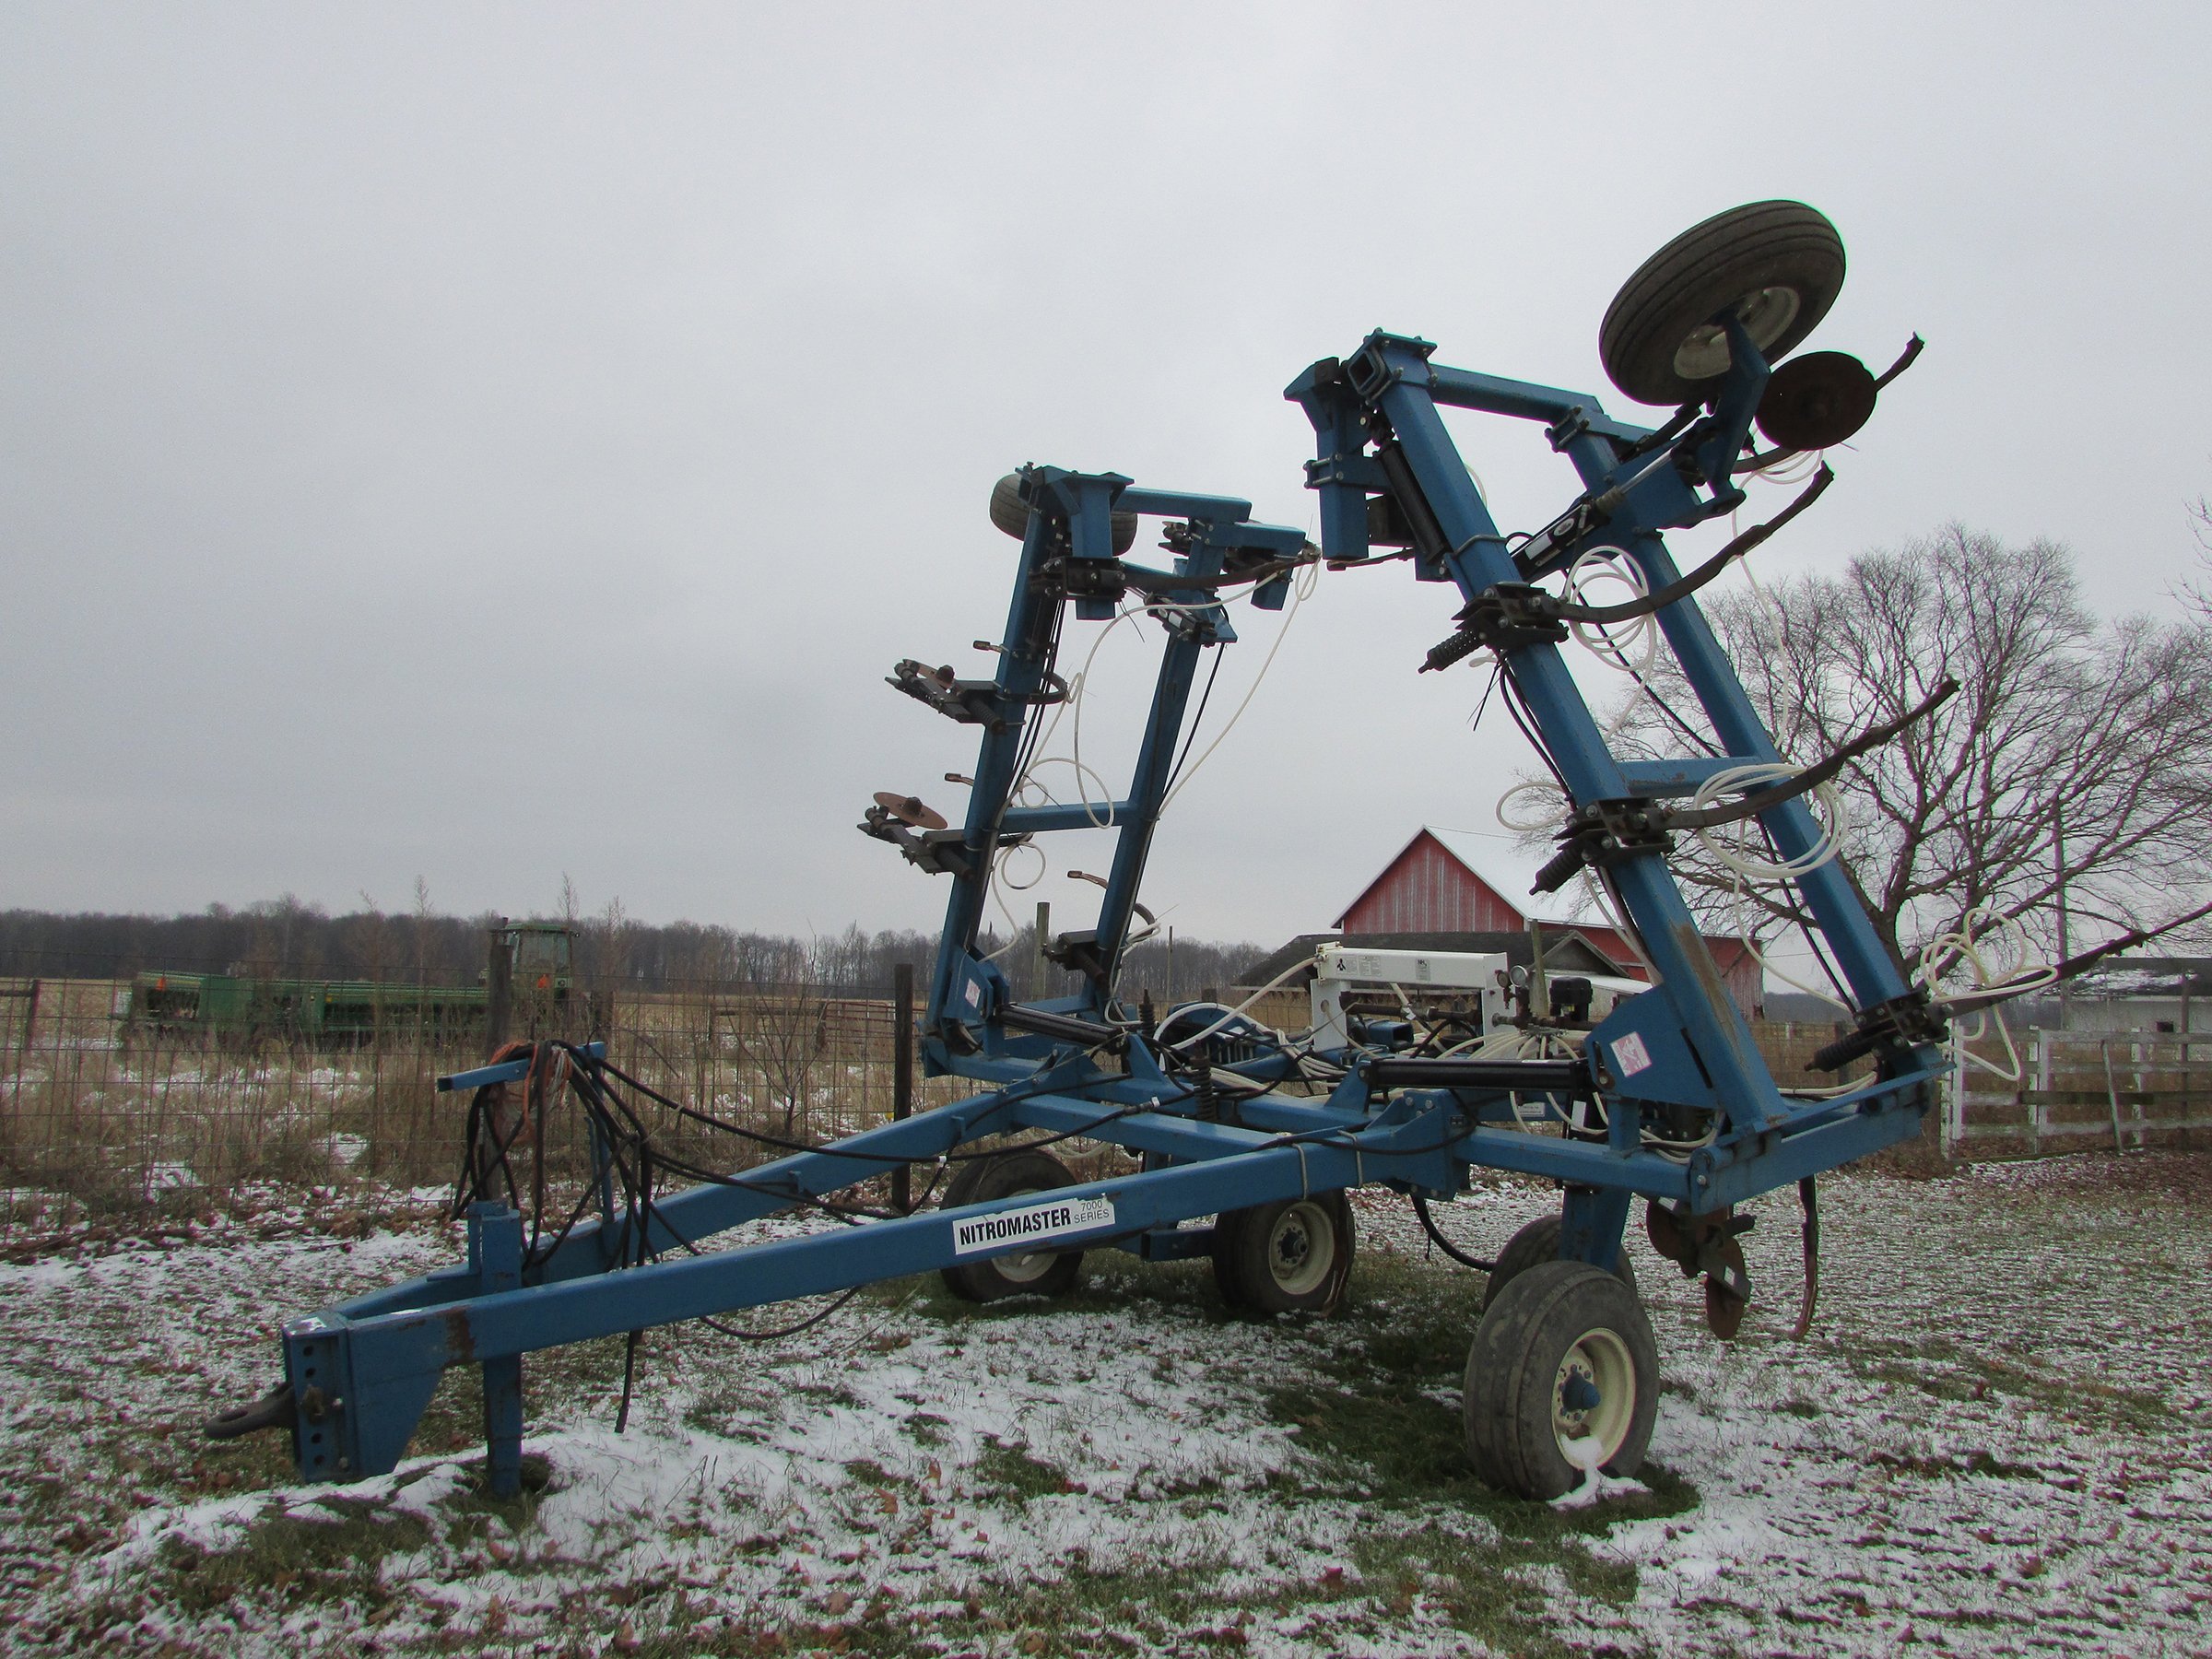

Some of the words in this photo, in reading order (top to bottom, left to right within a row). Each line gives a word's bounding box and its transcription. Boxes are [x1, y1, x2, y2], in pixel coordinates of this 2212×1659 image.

[1080, 1200, 1103, 1212] 7000
[1074, 1209, 1110, 1224] SERIES
[959, 1207, 1071, 1245] NITROMASTER
